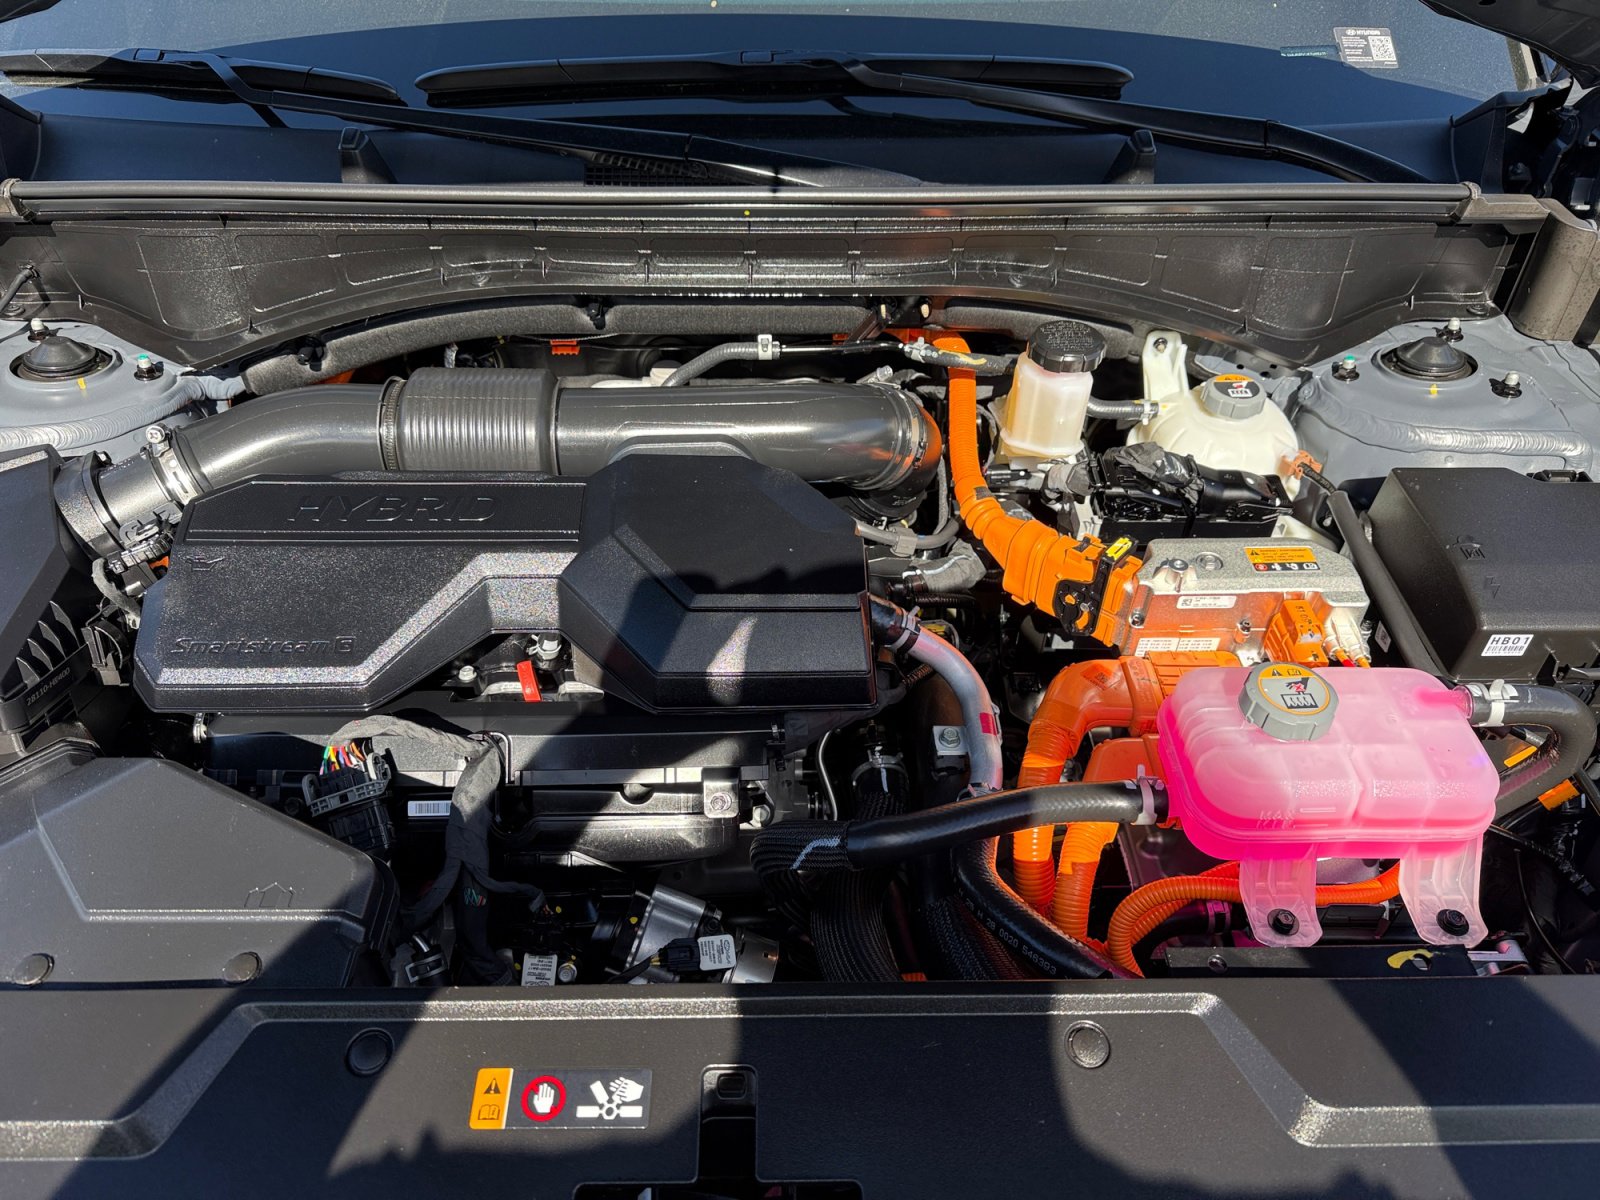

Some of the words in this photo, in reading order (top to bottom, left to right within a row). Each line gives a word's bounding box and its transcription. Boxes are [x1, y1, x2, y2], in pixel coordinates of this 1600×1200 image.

[286, 495, 499, 522] HYBRID
[170, 636, 330, 654] Smartstream
[335, 635, 357, 653] G
[1490, 636, 1531, 645] HB01
